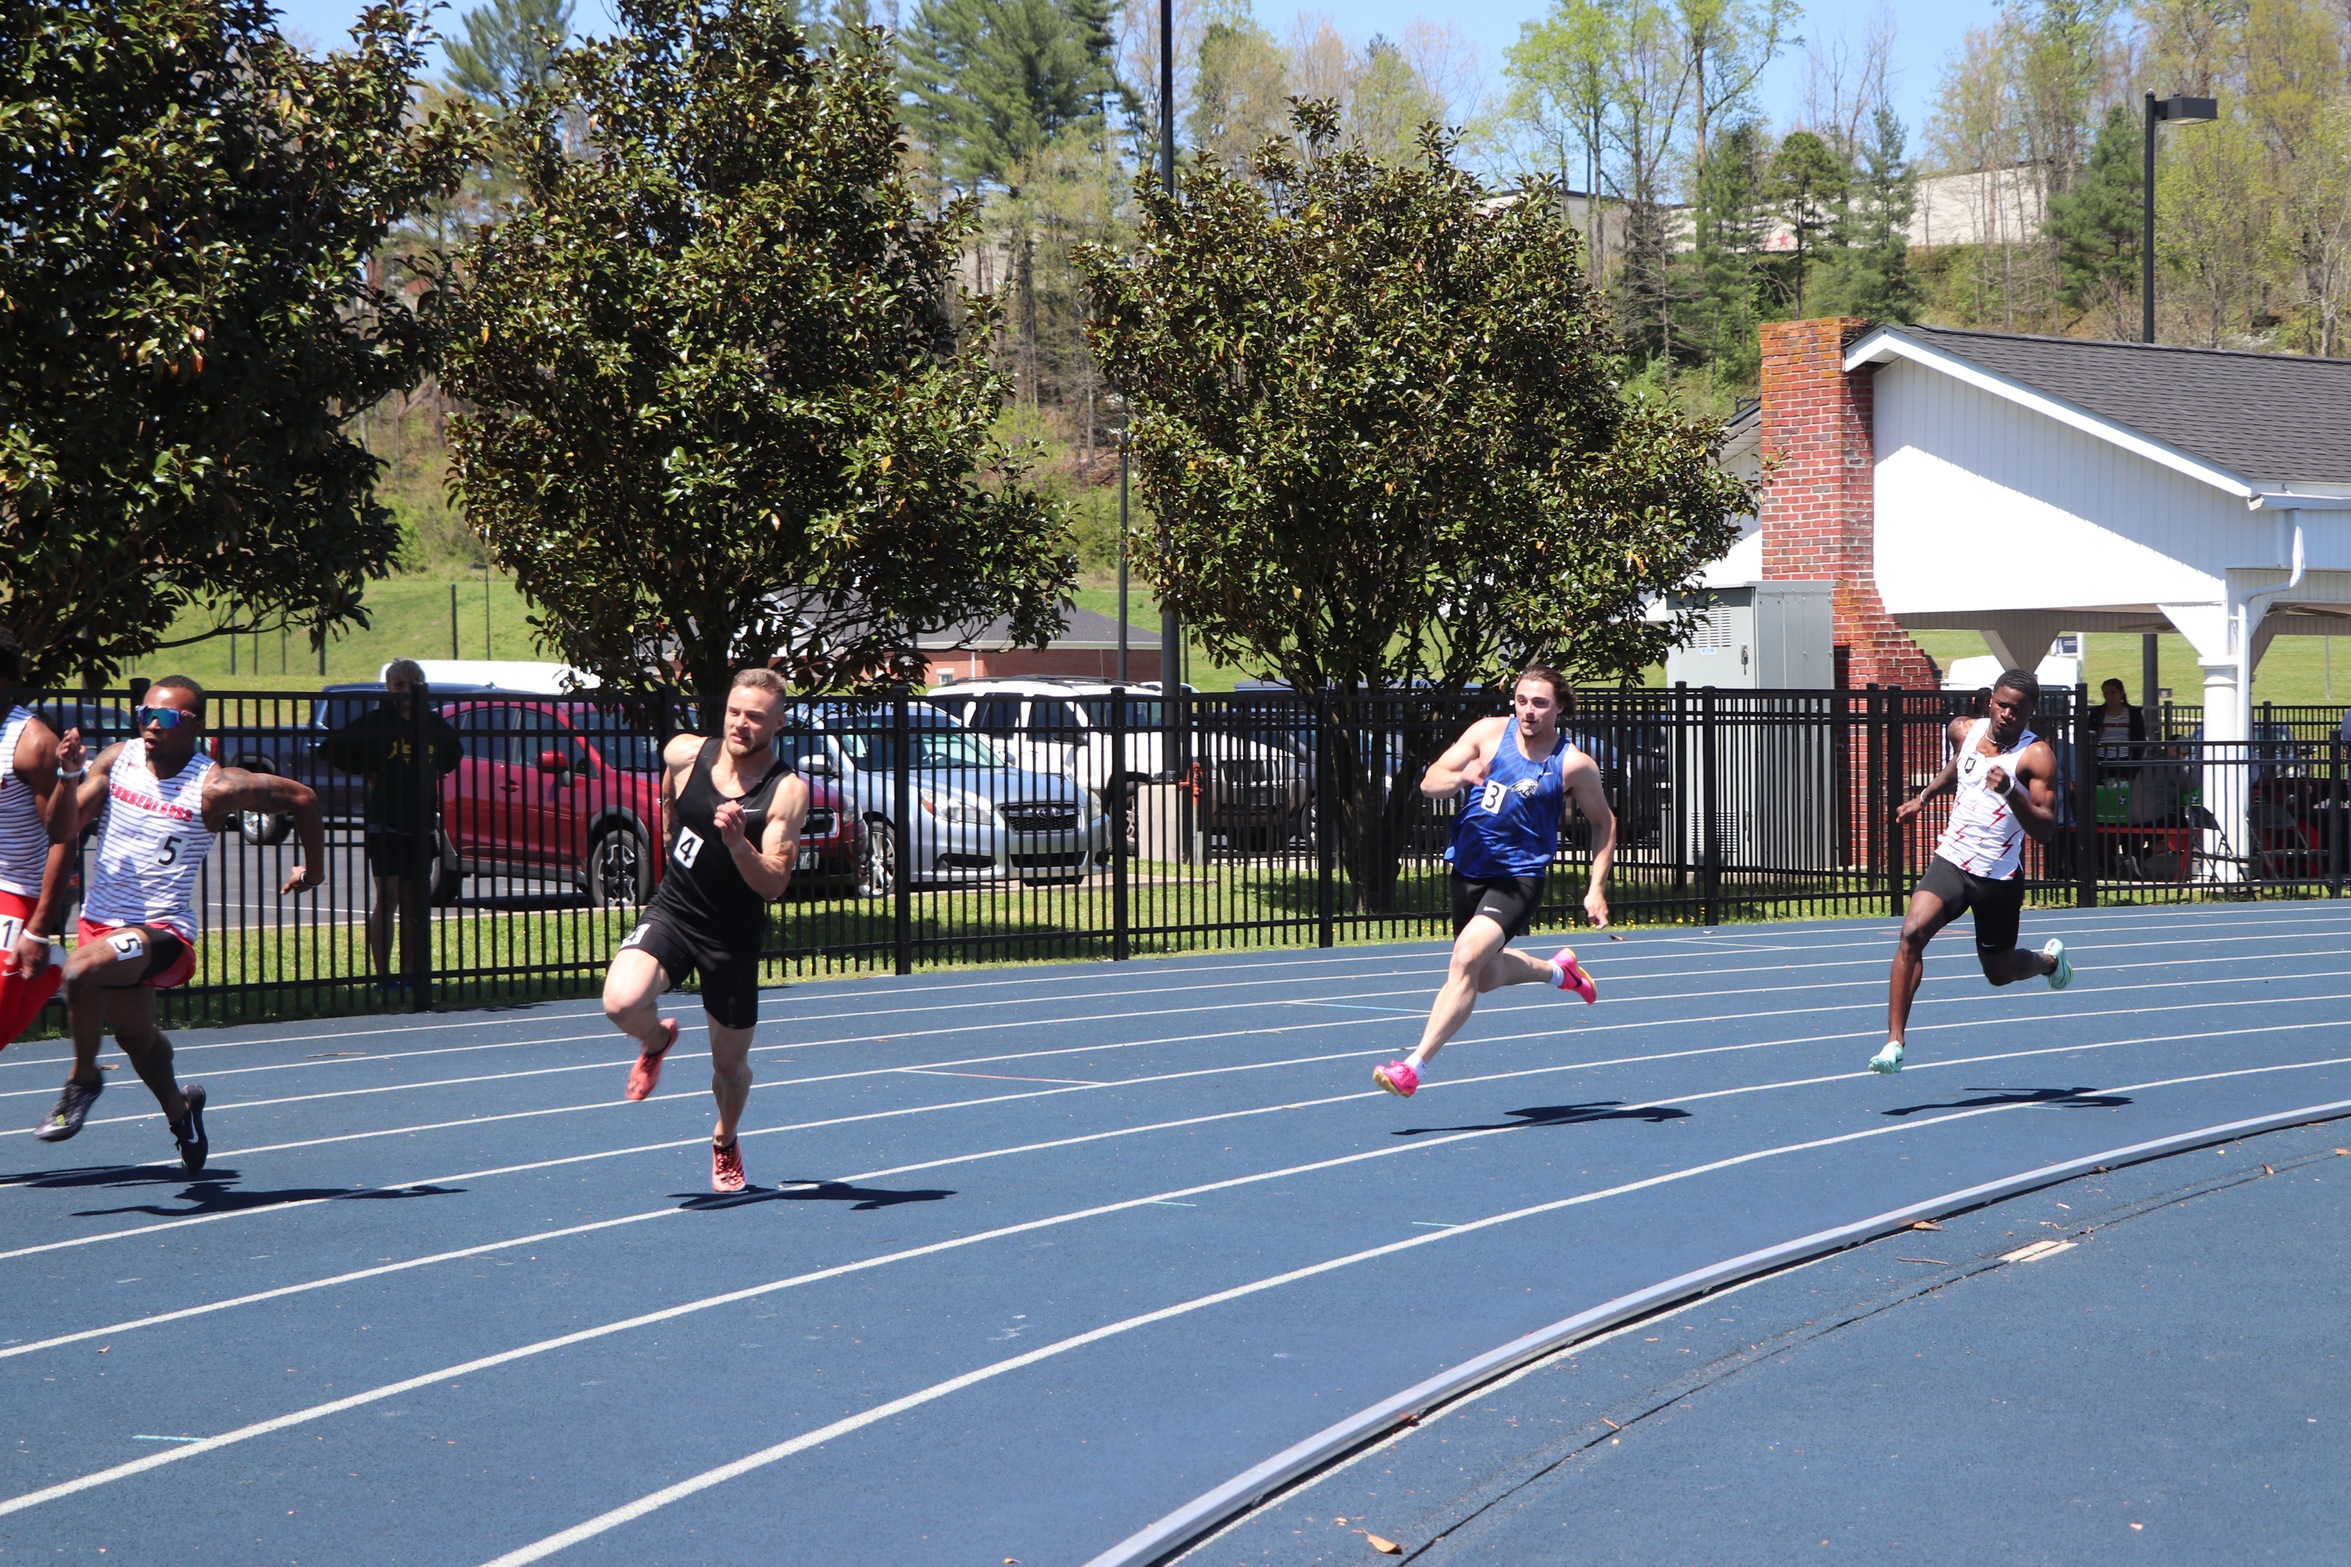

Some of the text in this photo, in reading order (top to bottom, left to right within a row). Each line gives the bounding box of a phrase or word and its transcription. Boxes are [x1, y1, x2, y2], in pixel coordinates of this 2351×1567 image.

[1485, 785, 1500, 809] 3
[158, 835, 182, 865] 5
[680, 836, 696, 862] 4
[114, 937, 141, 953] 5
